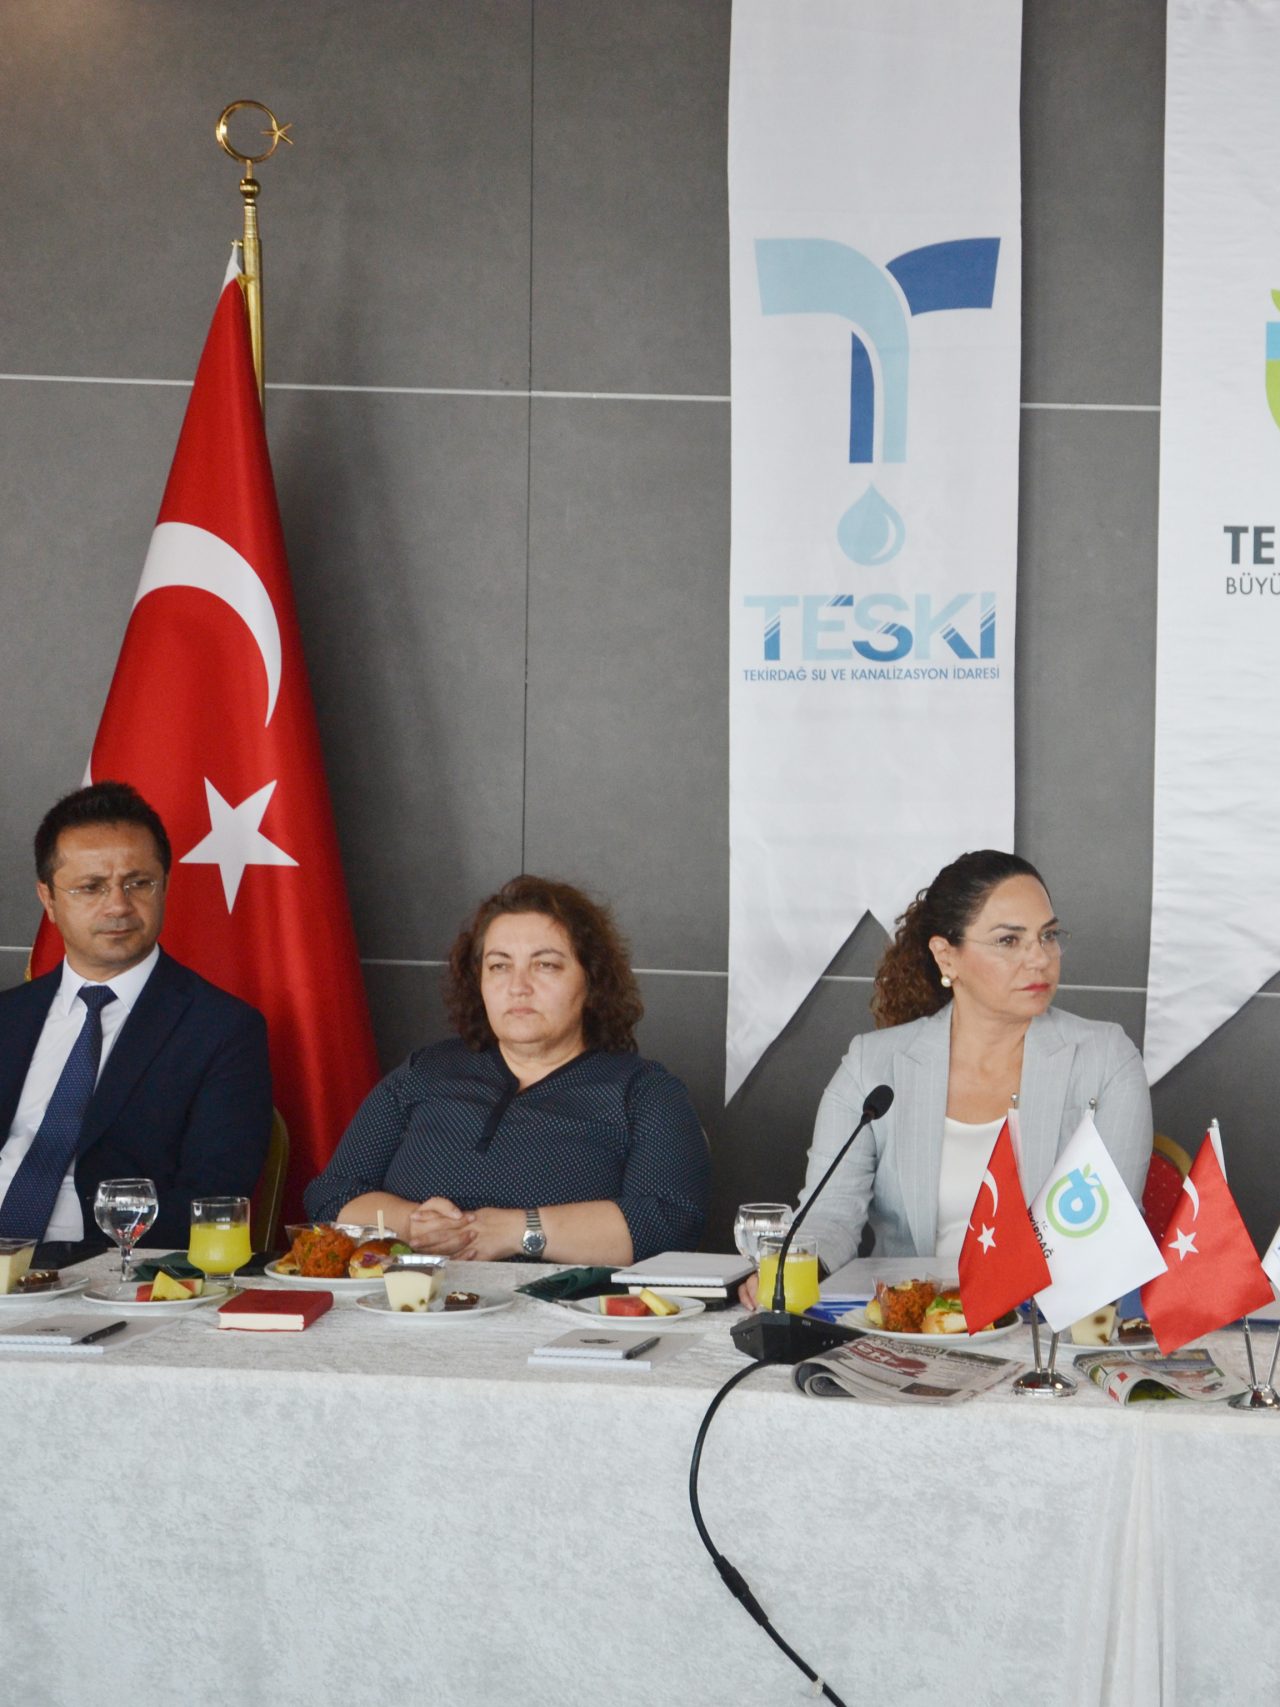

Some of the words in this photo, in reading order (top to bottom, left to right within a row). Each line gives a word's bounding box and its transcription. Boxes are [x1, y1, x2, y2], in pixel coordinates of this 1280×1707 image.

[743, 666, 807, 681] TEKİRDAĞ
[811, 668, 827, 681] SU
[831, 668, 846, 680] VE
[851, 666, 949, 680] KANALİZASYON
[953, 665, 1000, 680] İDARESİ
